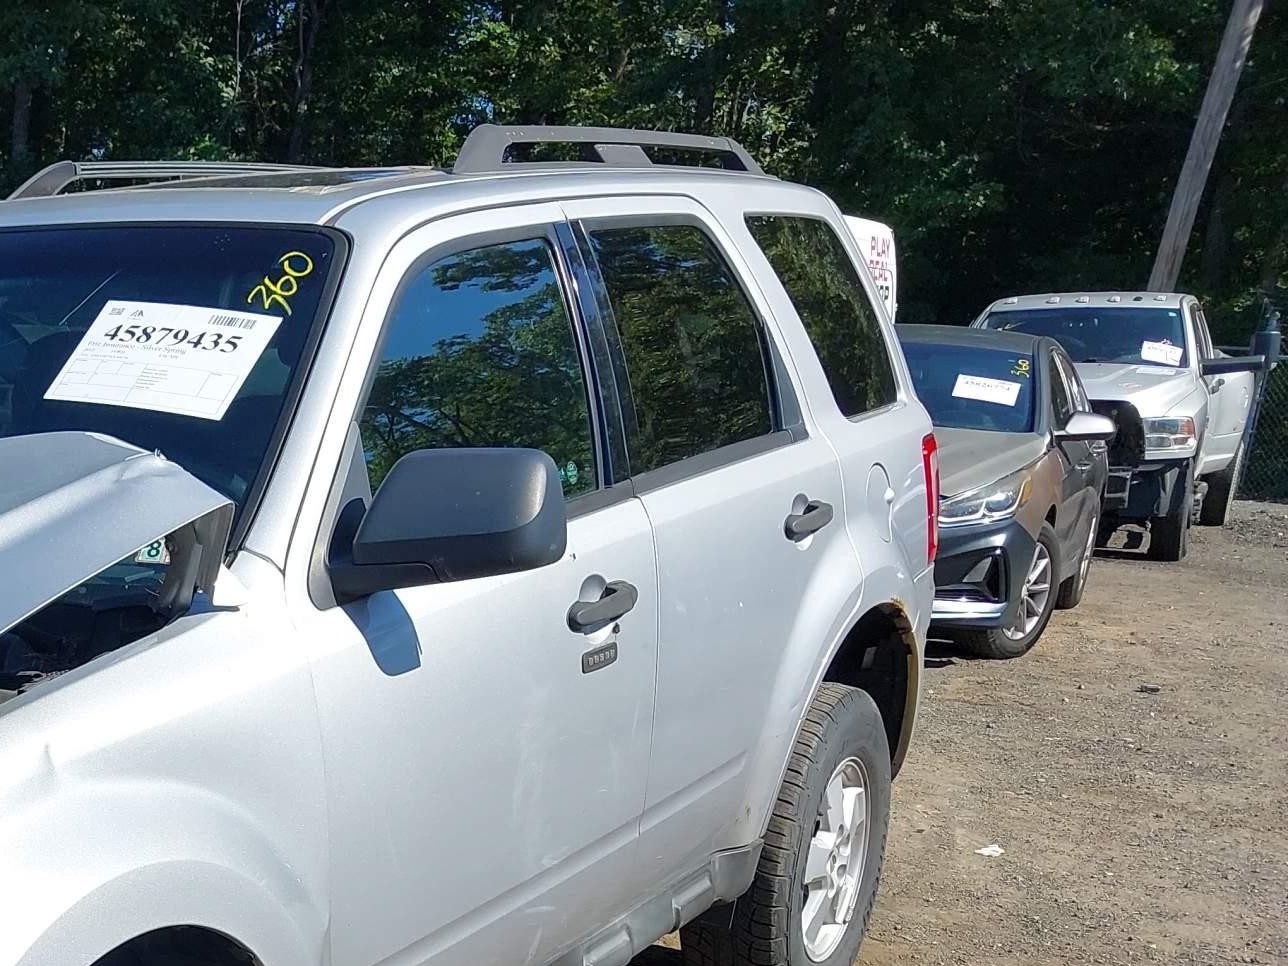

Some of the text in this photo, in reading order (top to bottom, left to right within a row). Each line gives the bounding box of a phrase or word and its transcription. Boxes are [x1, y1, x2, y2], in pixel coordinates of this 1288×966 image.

[870, 236, 890, 258] PLAY
[247, 251, 313, 316] 360
[104, 324, 243, 353] 45879435
